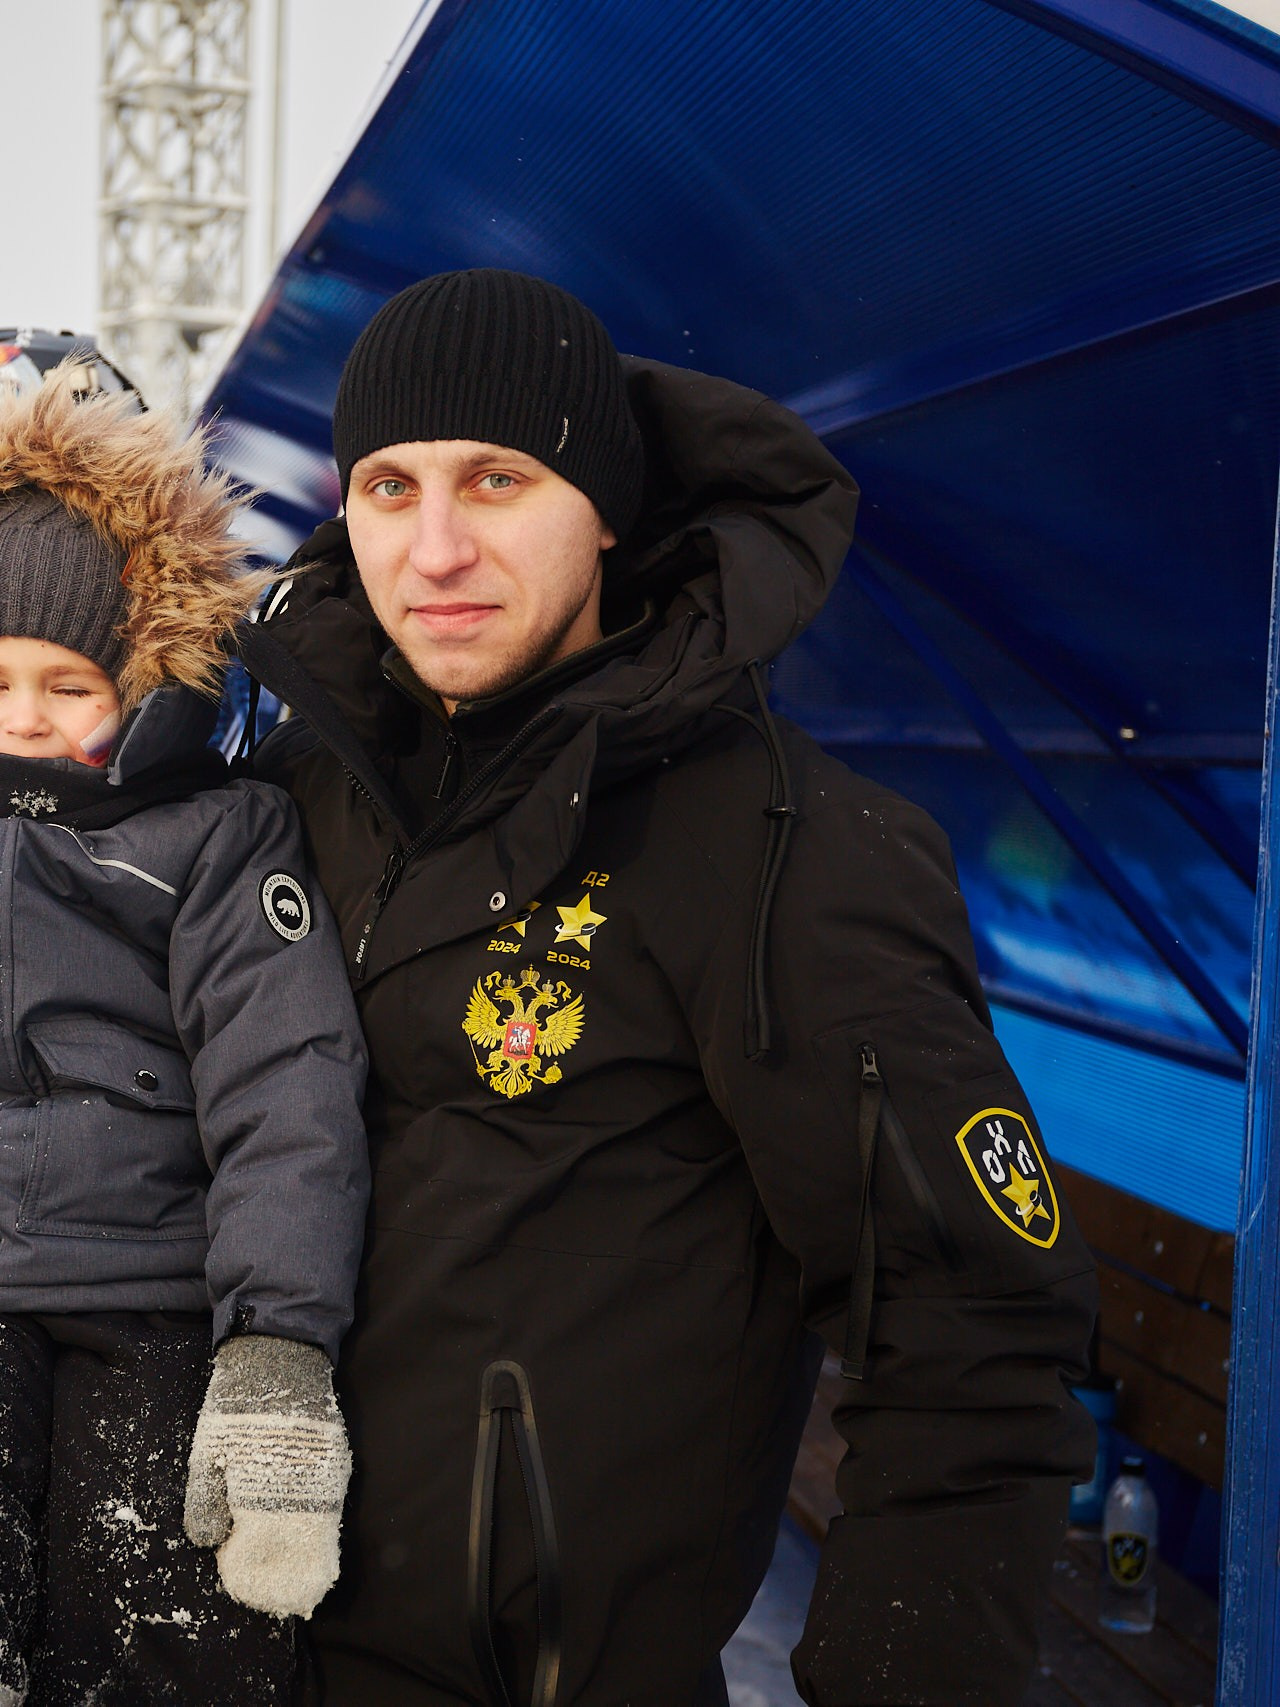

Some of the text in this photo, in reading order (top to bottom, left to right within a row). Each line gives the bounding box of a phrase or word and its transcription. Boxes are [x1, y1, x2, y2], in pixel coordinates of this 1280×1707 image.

[581, 871, 610, 887] Д2
[268, 912, 279, 926] WILD
[487, 940, 521, 954] 2024
[546, 950, 591, 970] 2024
